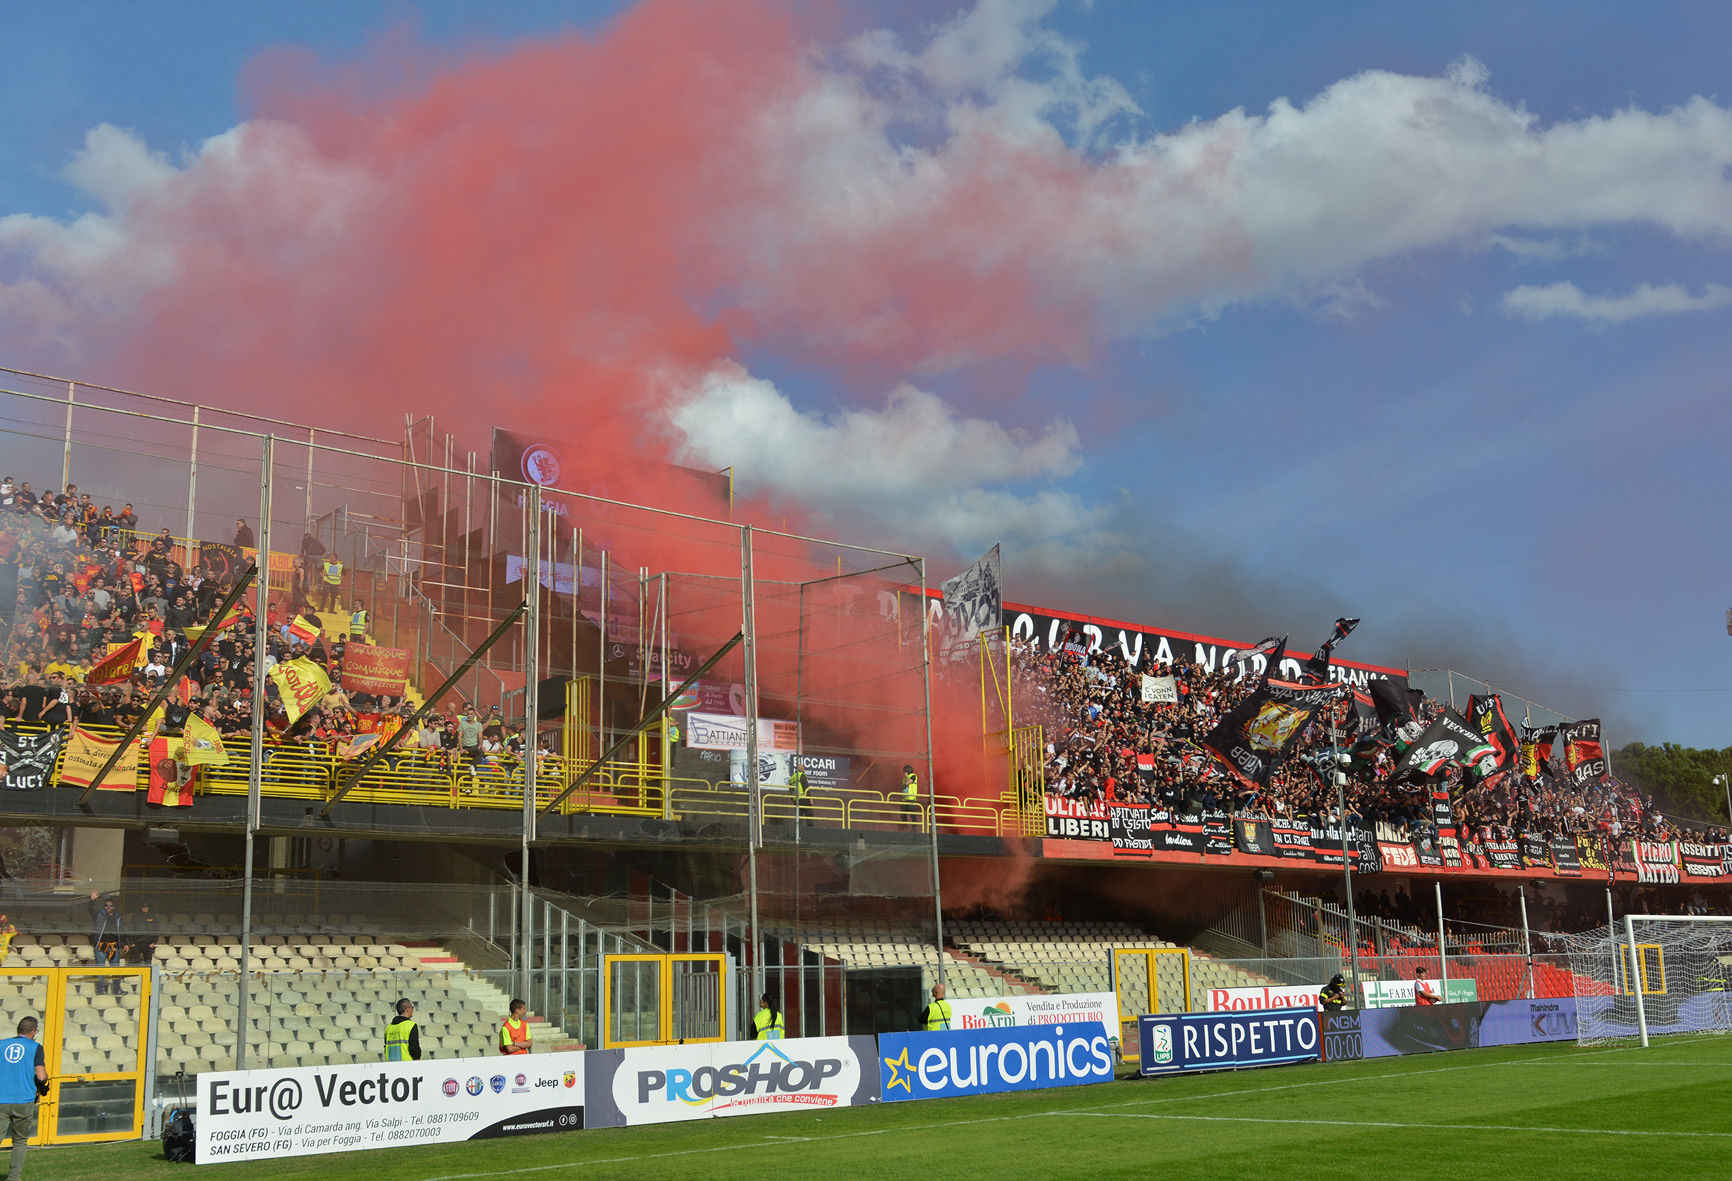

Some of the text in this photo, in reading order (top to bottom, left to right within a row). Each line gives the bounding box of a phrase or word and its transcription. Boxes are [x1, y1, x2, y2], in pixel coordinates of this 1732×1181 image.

[202, 544, 238, 559] NOSTALGIA
[346, 660, 405, 677] COMUNQUE
[695, 727, 748, 744] BATTIANT
[6, 775, 43, 789] LUCY
[1048, 818, 1110, 838] LIBERI
[1381, 846, 1418, 866] FEDE
[1641, 842, 1673, 862] PIERO
[1680, 842, 1719, 857] ASSENTI
[1637, 863, 1680, 884] MATTEO
[1211, 988, 1320, 1011] Boulevar
[1388, 988, 1415, 999] FARM
[1026, 1001, 1055, 1012] Vendita
[1062, 999, 1102, 1010] Produzione
[1027, 1011, 1103, 1025] di PRODOTTI BIO
[1327, 1015, 1361, 1031] NGM
[1183, 1018, 1317, 1059] RISPETTO
[1325, 1031, 1362, 1061] 00:00
[918, 1026, 1111, 1090] euronics
[534, 1078, 559, 1089] Jeep
[638, 1058, 841, 1104] PROSHOP
[209, 1072, 423, 1120] Eur@ Vector
[776, 1093, 792, 1102] che
[794, 1095, 833, 1106] conviene
[210, 1129, 246, 1142] FOGGIA
[248, 1127, 269, 1140] (FG)
[278, 1126, 292, 1136] Via
[294, 1124, 302, 1135] di
[304, 1120, 344, 1134] Camarda
[345, 1122, 362, 1132] ang.
[365, 1119, 379, 1129] Via
[381, 1116, 403, 1129] Salpi
[411, 1115, 425, 1125] Tel.
[427, 1111, 480, 1124] 0881709609
[210, 1145, 230, 1156] SAN
[232, 1141, 271, 1154] SEVERO
[273, 1139, 293, 1152] (FG)
[301, 1137, 315, 1148] Via
[317, 1138, 331, 1151] per
[332, 1134, 362, 1148] Foggia
[371, 1131, 385, 1142] Tel.
[387, 1127, 441, 1141] 0882070003
